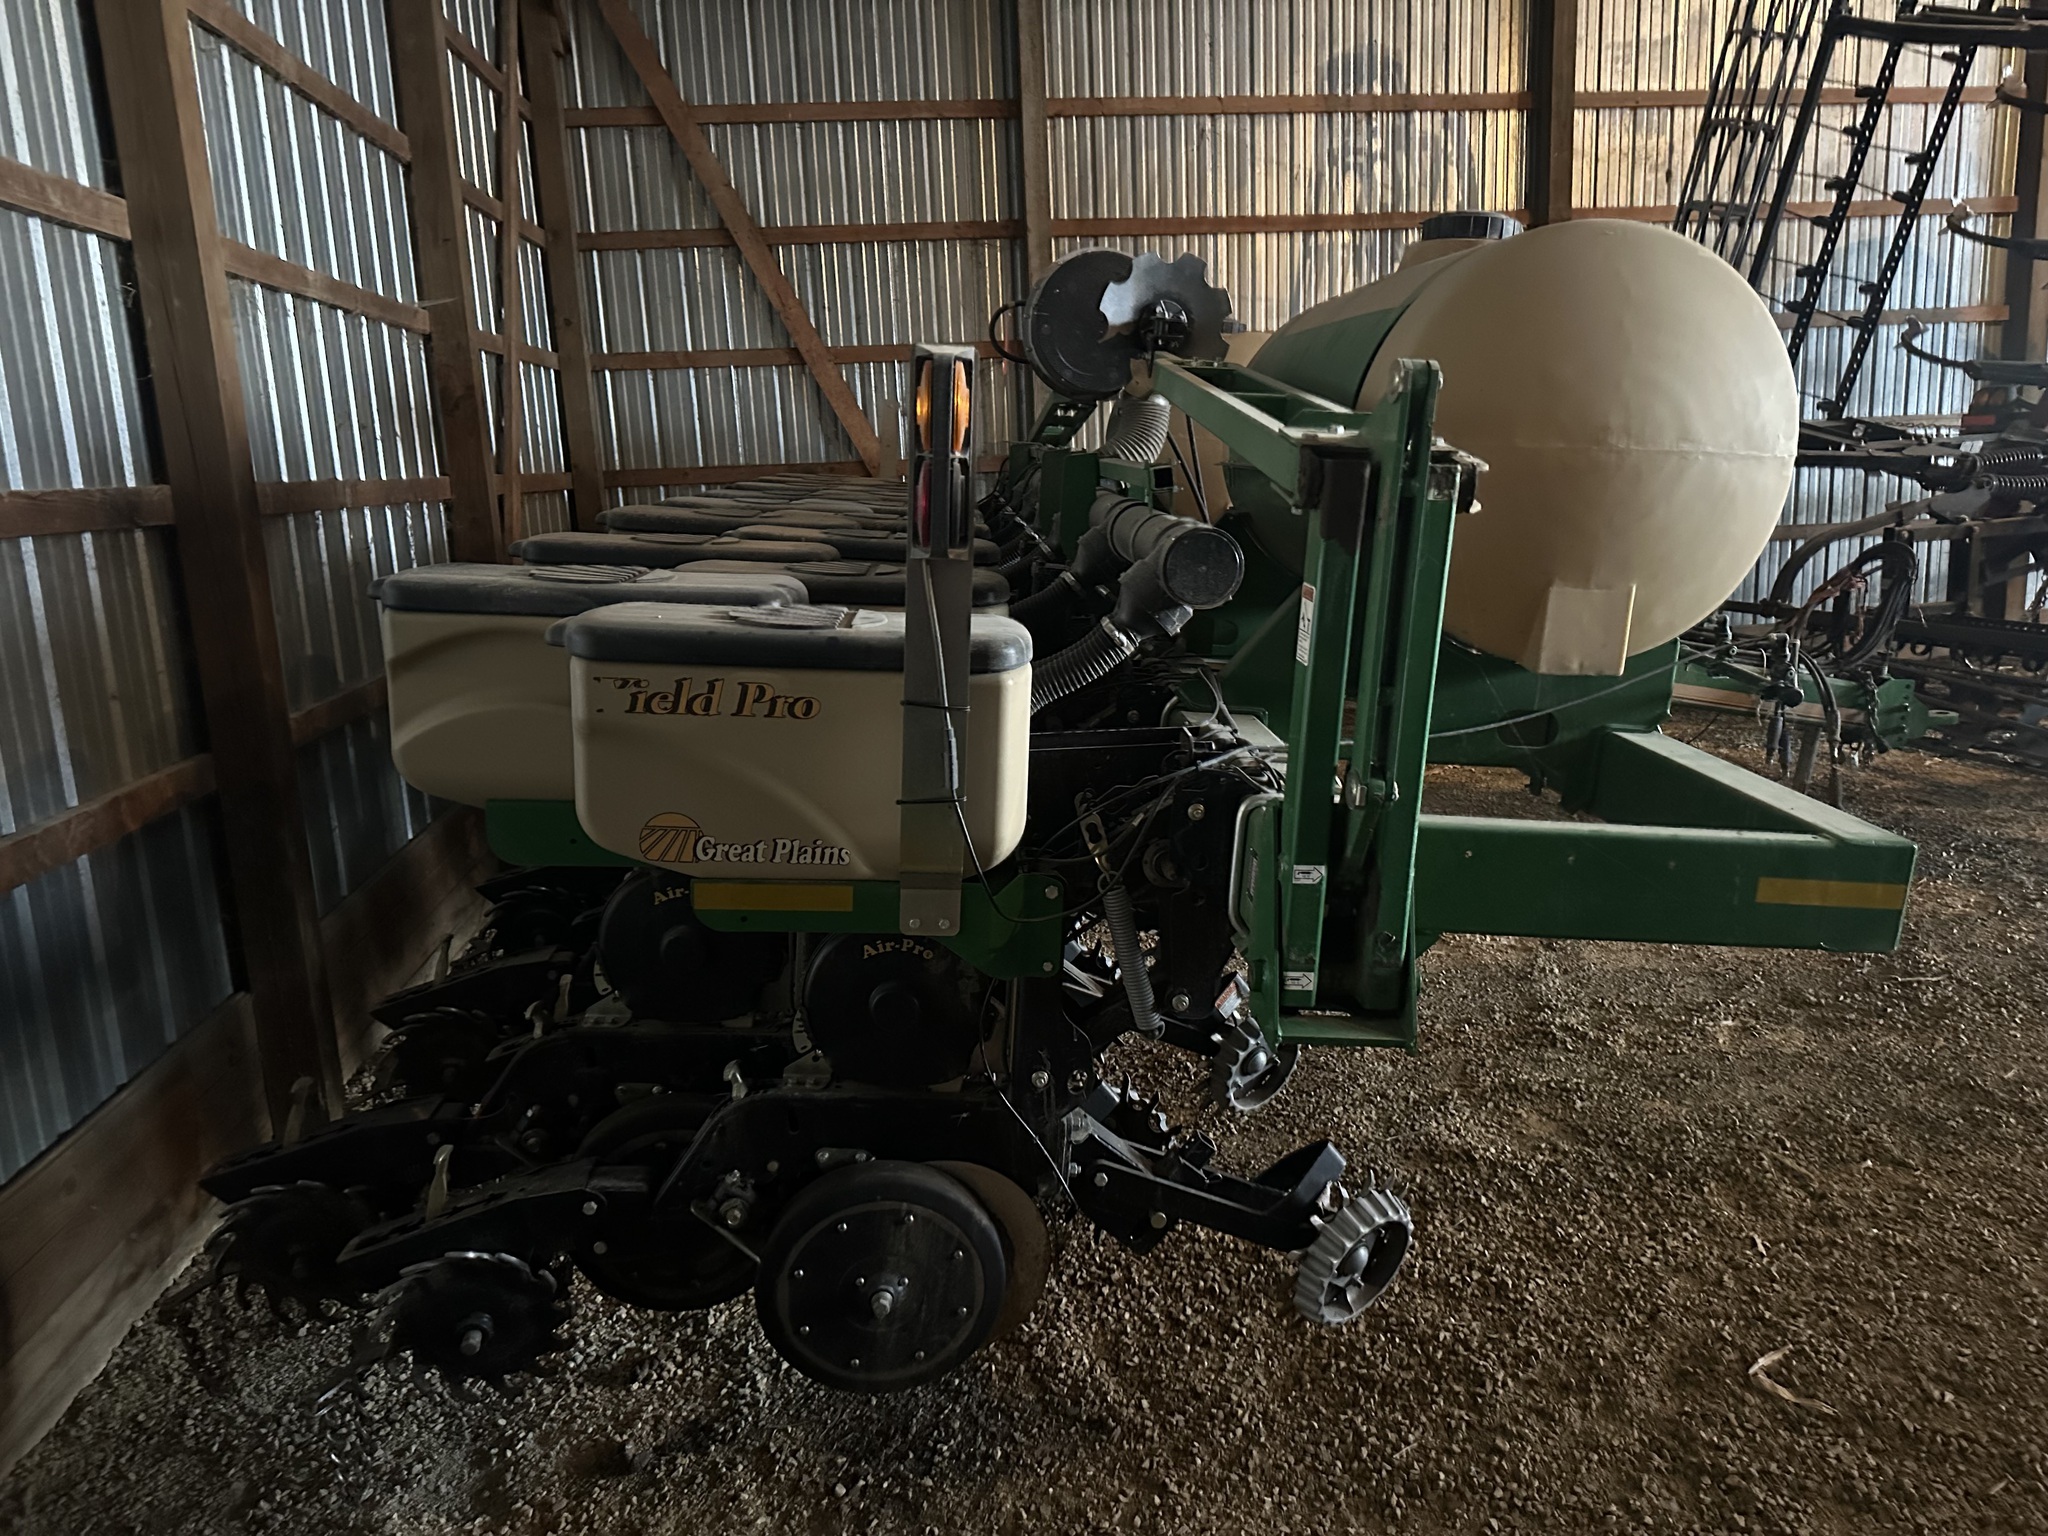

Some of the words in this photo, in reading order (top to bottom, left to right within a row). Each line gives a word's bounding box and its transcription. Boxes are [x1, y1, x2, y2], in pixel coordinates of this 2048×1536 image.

[593, 677, 725, 716] ield
[730, 681, 822, 720] Pro
[694, 834, 768, 863] Great
[770, 838, 851, 866] Plains
[862, 937, 934, 960] Air-Pro
